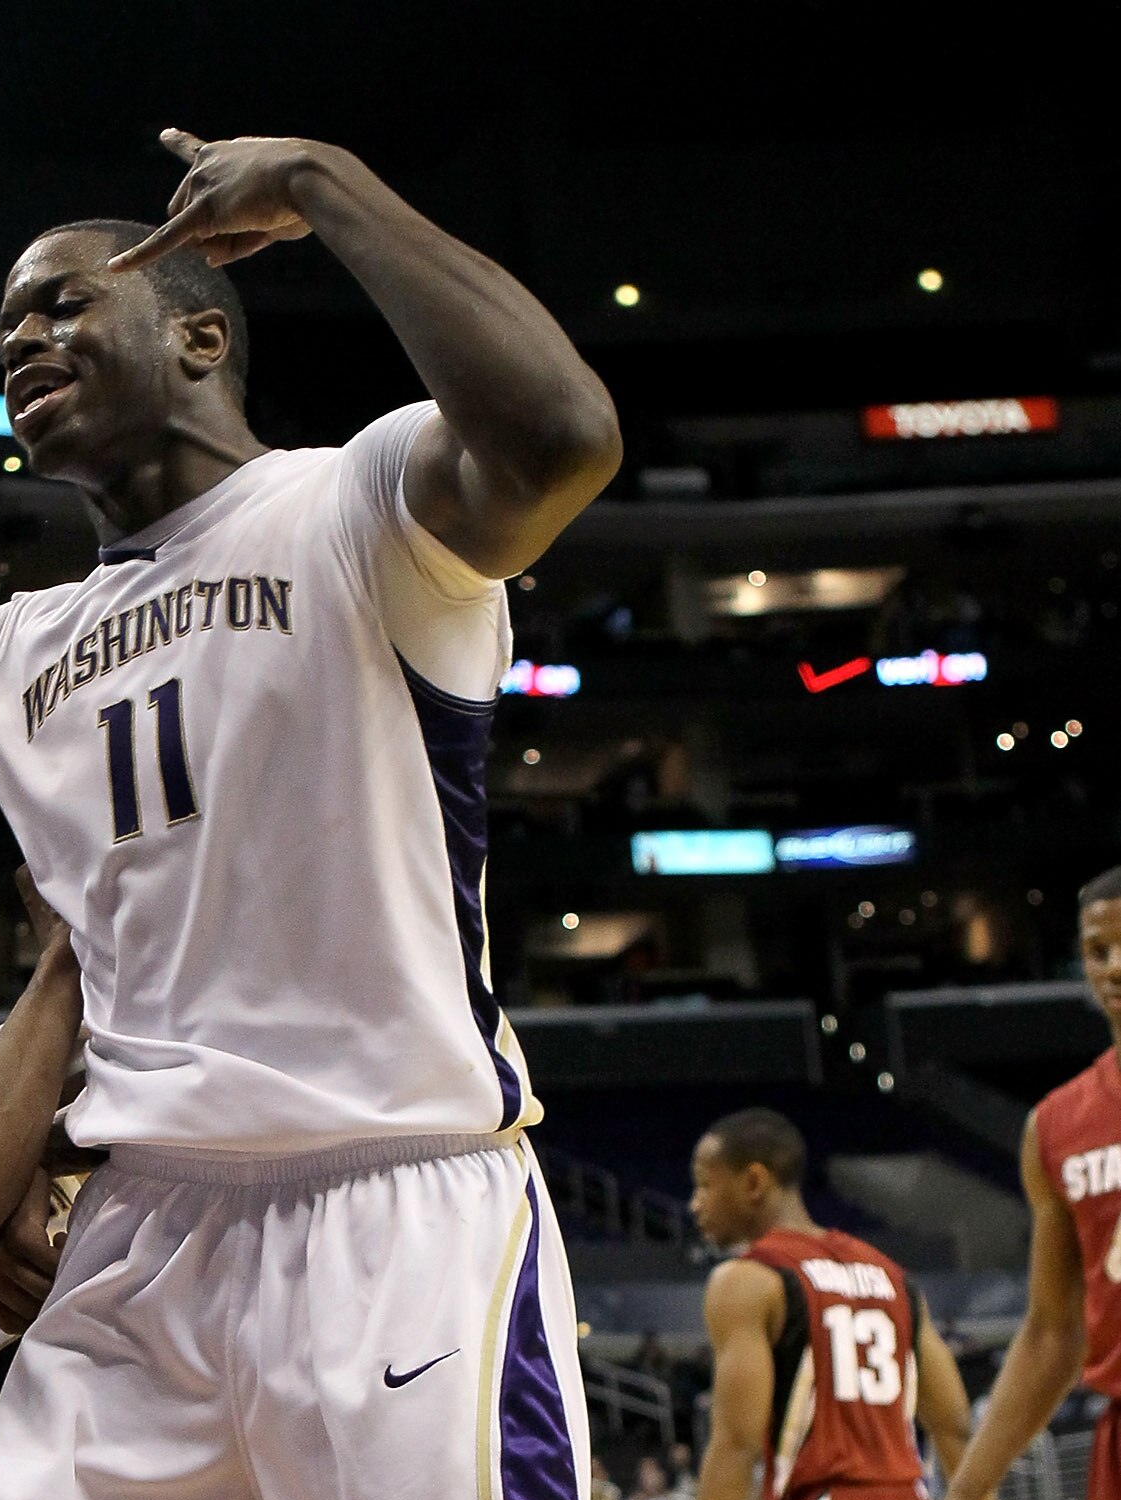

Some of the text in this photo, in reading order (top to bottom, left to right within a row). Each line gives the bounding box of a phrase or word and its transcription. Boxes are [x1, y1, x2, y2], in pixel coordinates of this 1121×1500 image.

[22, 575, 293, 743] WASHINGTON
[97, 678, 200, 845] 11
[822, 1304, 902, 1406] 13
